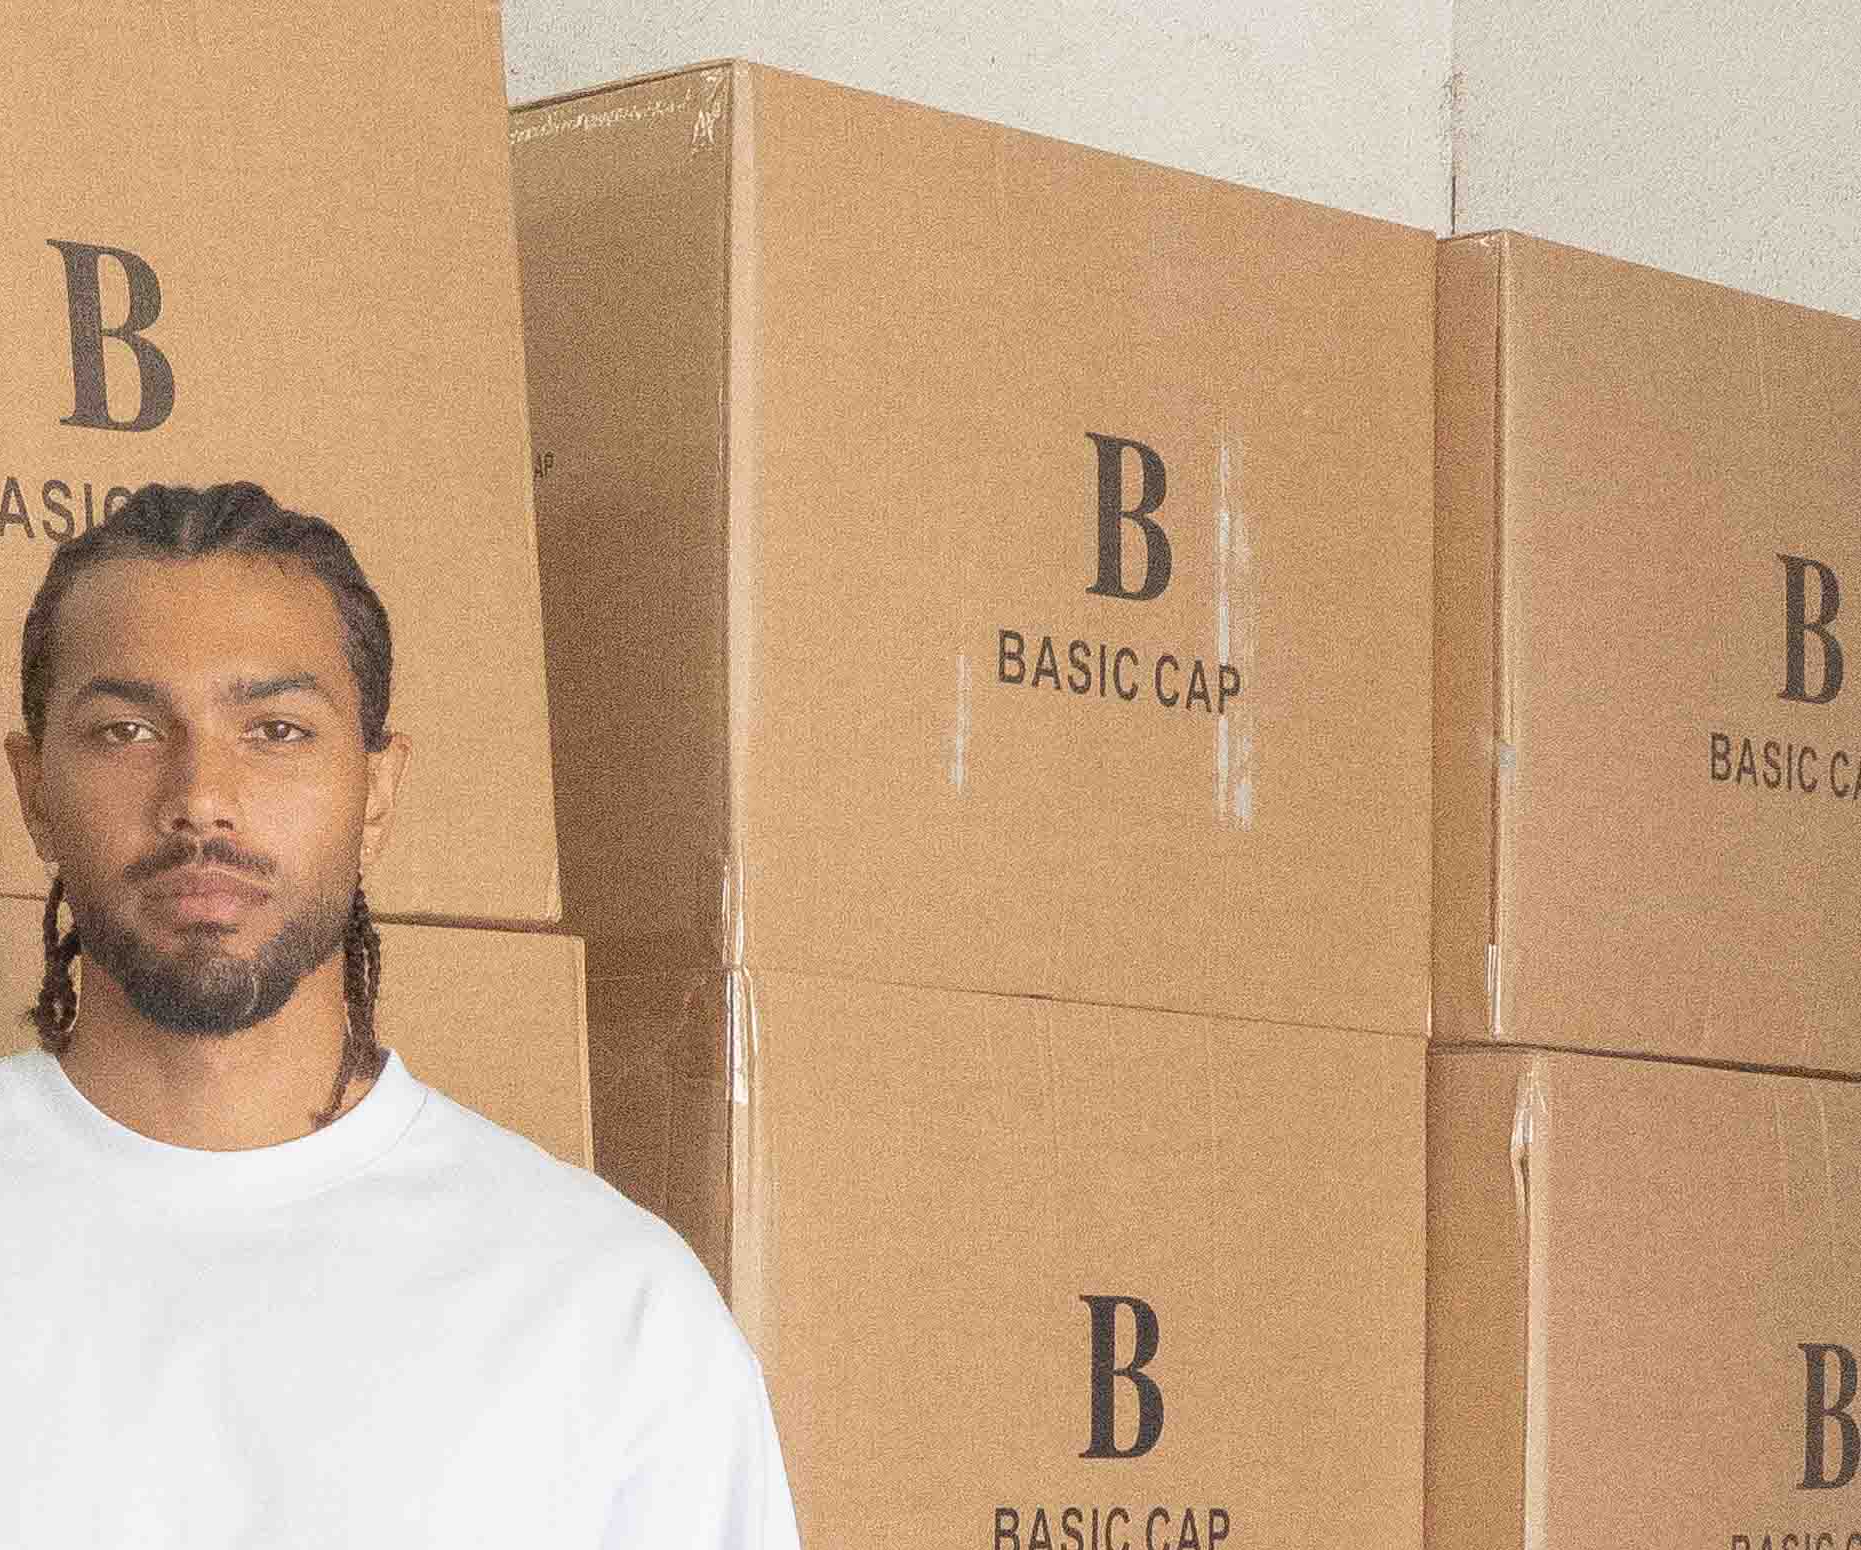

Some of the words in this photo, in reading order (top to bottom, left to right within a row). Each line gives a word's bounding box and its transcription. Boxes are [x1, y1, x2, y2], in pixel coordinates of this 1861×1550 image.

[46, 239, 176, 433] B
[1085, 432, 1173, 601] B
[998, 628, 1139, 701] BASIC
[1154, 655, 1241, 714] CAP
[1773, 551, 1844, 704] B
[1710, 733, 1818, 793] BASIC
[1078, 1294, 1164, 1459] B
[1795, 1342, 1860, 1490] B
